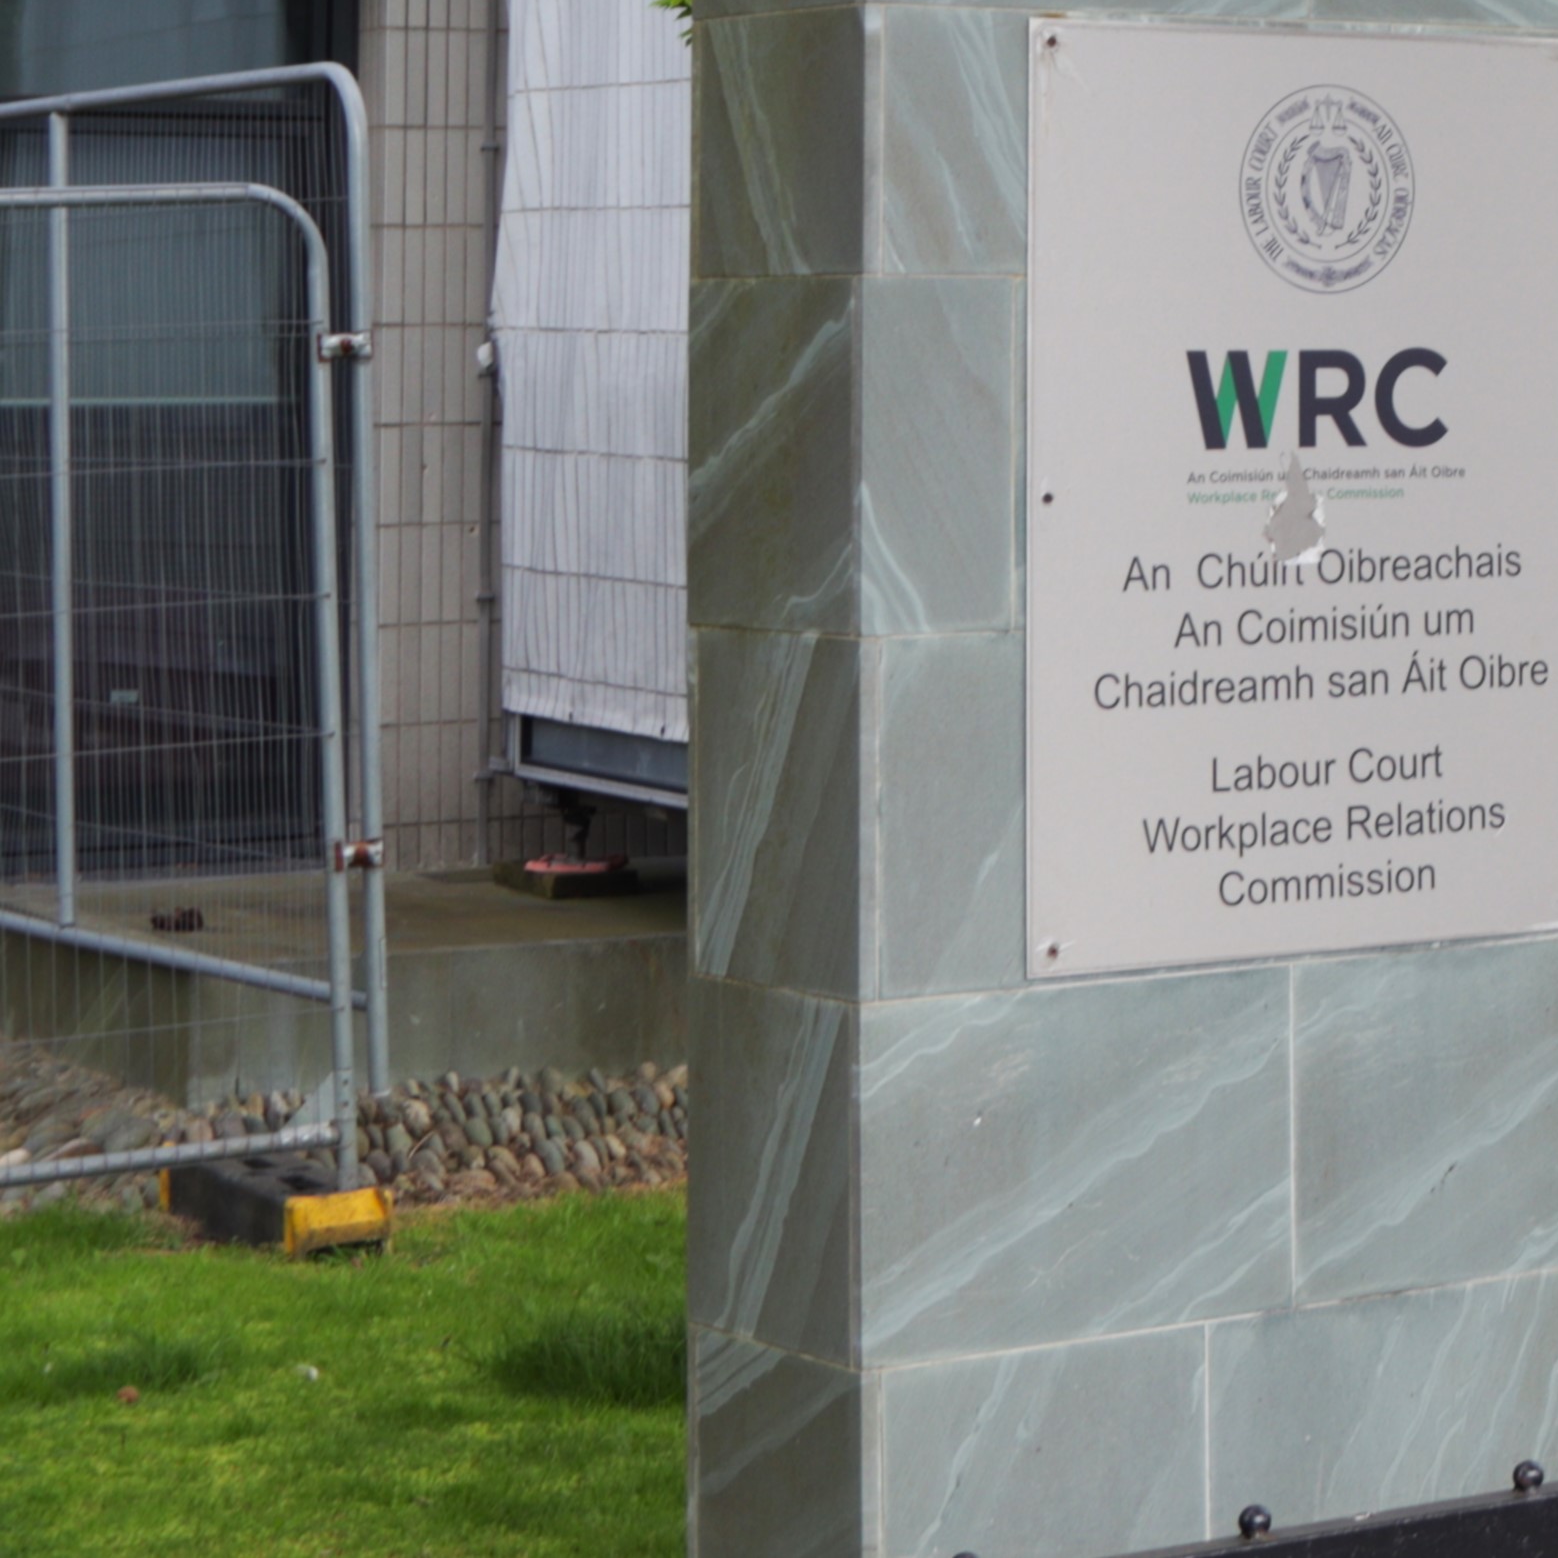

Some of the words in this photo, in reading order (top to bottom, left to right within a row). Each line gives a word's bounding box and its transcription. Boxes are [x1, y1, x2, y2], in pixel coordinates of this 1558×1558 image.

[1186, 346, 1449, 451] WRC
[1186, 471, 1205, 485] An
[1209, 467, 1274, 484] Coimisiún
[1302, 466, 1380, 482] Chaidreamh
[1384, 468, 1405, 480] san
[1409, 462, 1428, 480] Áit
[1430, 464, 1466, 479] Oibre
[1187, 489, 1257, 505] Workplace
[1326, 485, 1404, 501] Commission
[1122, 554, 1171, 593] An
[1317, 543, 1522, 586] Oibreachais
[1174, 611, 1222, 649] An
[1237, 603, 1409, 646] Coimisiún
[1424, 607, 1474, 637] um
[1093, 665, 1314, 711] Chaidreamh
[1328, 668, 1389, 699] san
[1401, 650, 1447, 695] Áit
[1458, 653, 1550, 693] Oibre
[1211, 754, 1336, 794] Labour
[1348, 743, 1444, 785] Court
[1142, 811, 1333, 858] Workplace
[1346, 797, 1506, 841] Relations
[1218, 859, 1436, 908] Commission
